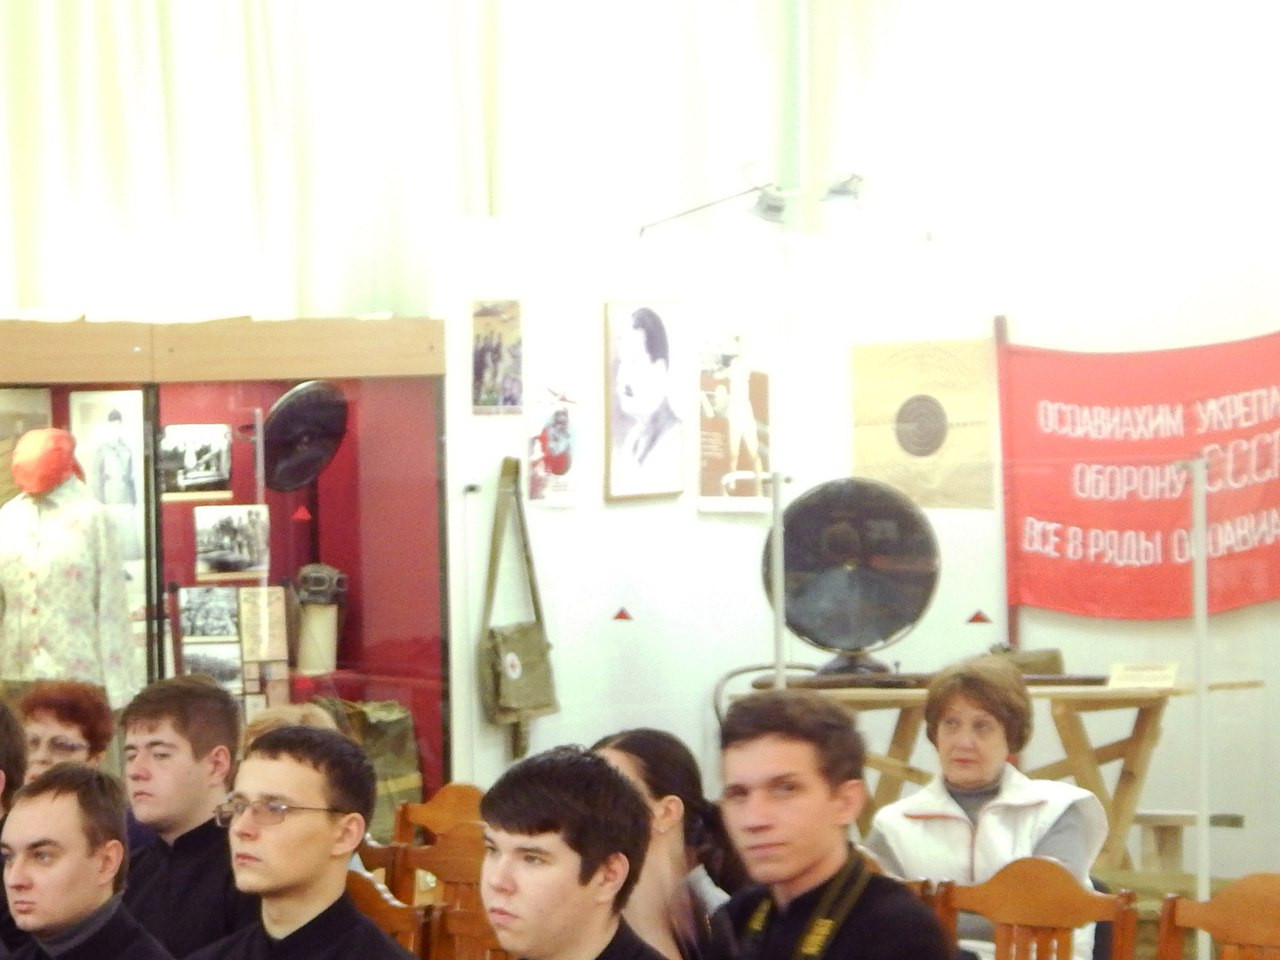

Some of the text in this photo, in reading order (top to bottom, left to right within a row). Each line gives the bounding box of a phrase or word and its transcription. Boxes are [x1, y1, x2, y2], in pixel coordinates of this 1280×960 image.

[1073, 463, 1188, 501] ОБОРОНУ
[1022, 507, 1280, 568] ВСЕ В РЯДЫ ООАВИА
